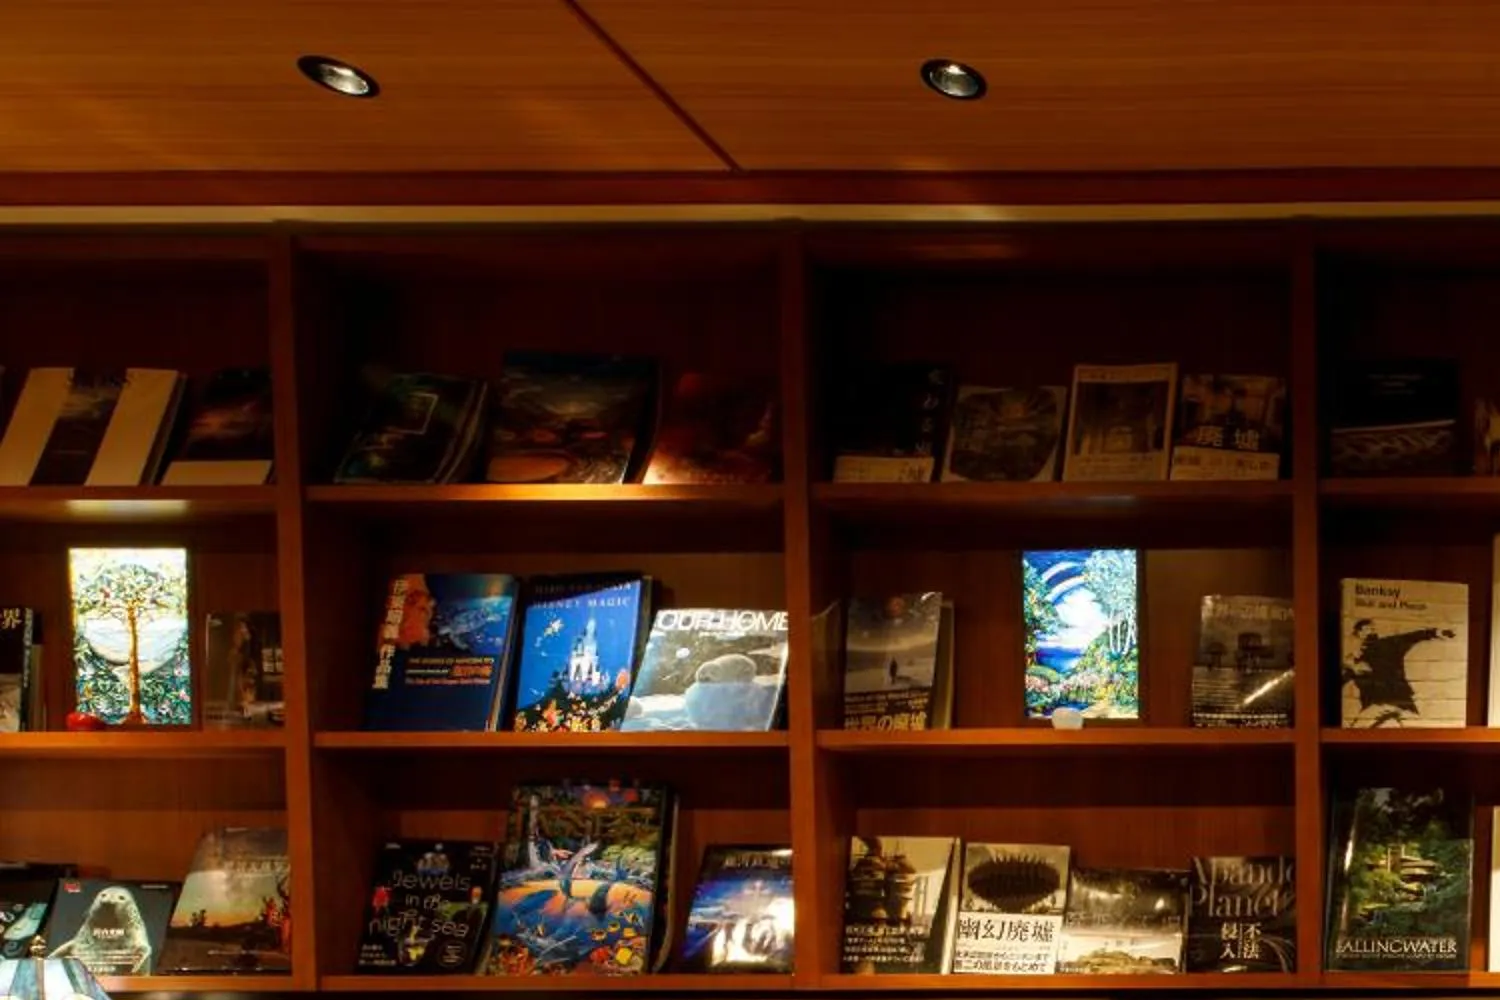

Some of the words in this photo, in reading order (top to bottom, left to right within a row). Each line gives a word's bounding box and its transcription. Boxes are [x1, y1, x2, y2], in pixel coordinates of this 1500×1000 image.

[405, 893, 420, 907] in
[432, 917, 469, 938] sea
[1336, 936, 1458, 954] FALLINGWATER
